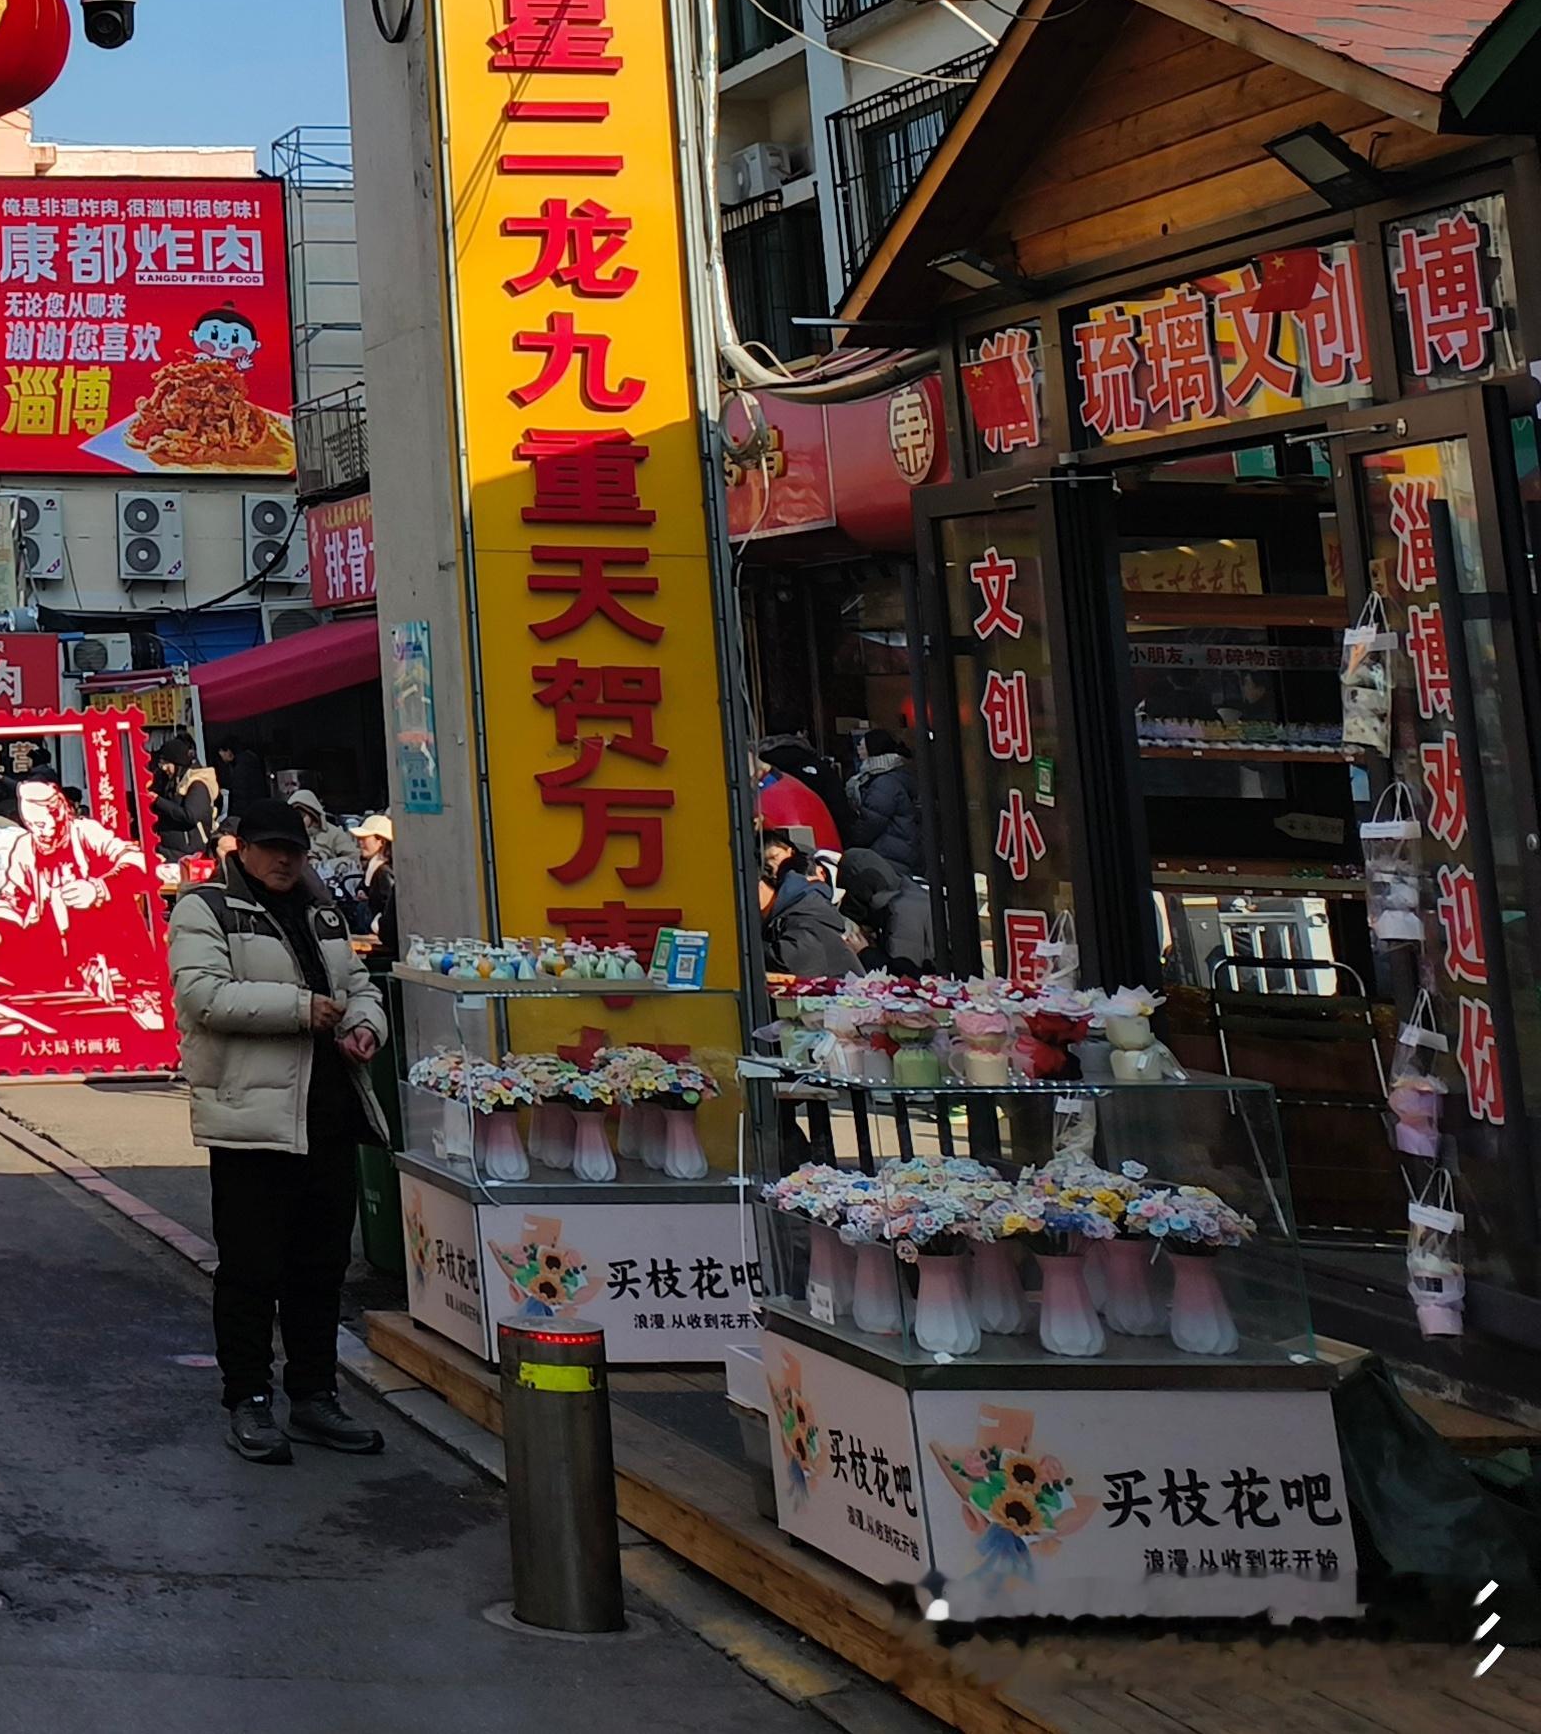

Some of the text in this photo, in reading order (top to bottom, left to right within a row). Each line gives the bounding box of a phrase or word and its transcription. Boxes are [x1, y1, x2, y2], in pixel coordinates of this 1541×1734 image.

[0, 222, 263, 284] 康都炸肉
[139, 274, 261, 284] KANGDU FRIED FOOD
[4, 292, 126, 319] 无论您从哪来
[1396, 211, 1494, 376] 博
[5, 321, 162, 362] 谢谢您喜欢
[0, 365, 112, 435] 淄博
[324, 526, 374, 600] 排骨
[20, 1037, 122, 1057] 八大局书画苑
[605, 1256, 769, 1301] 买枝花吧
[827, 1428, 918, 1519] 买枝花吧
[1101, 1468, 1343, 1530] 买枝花吧
